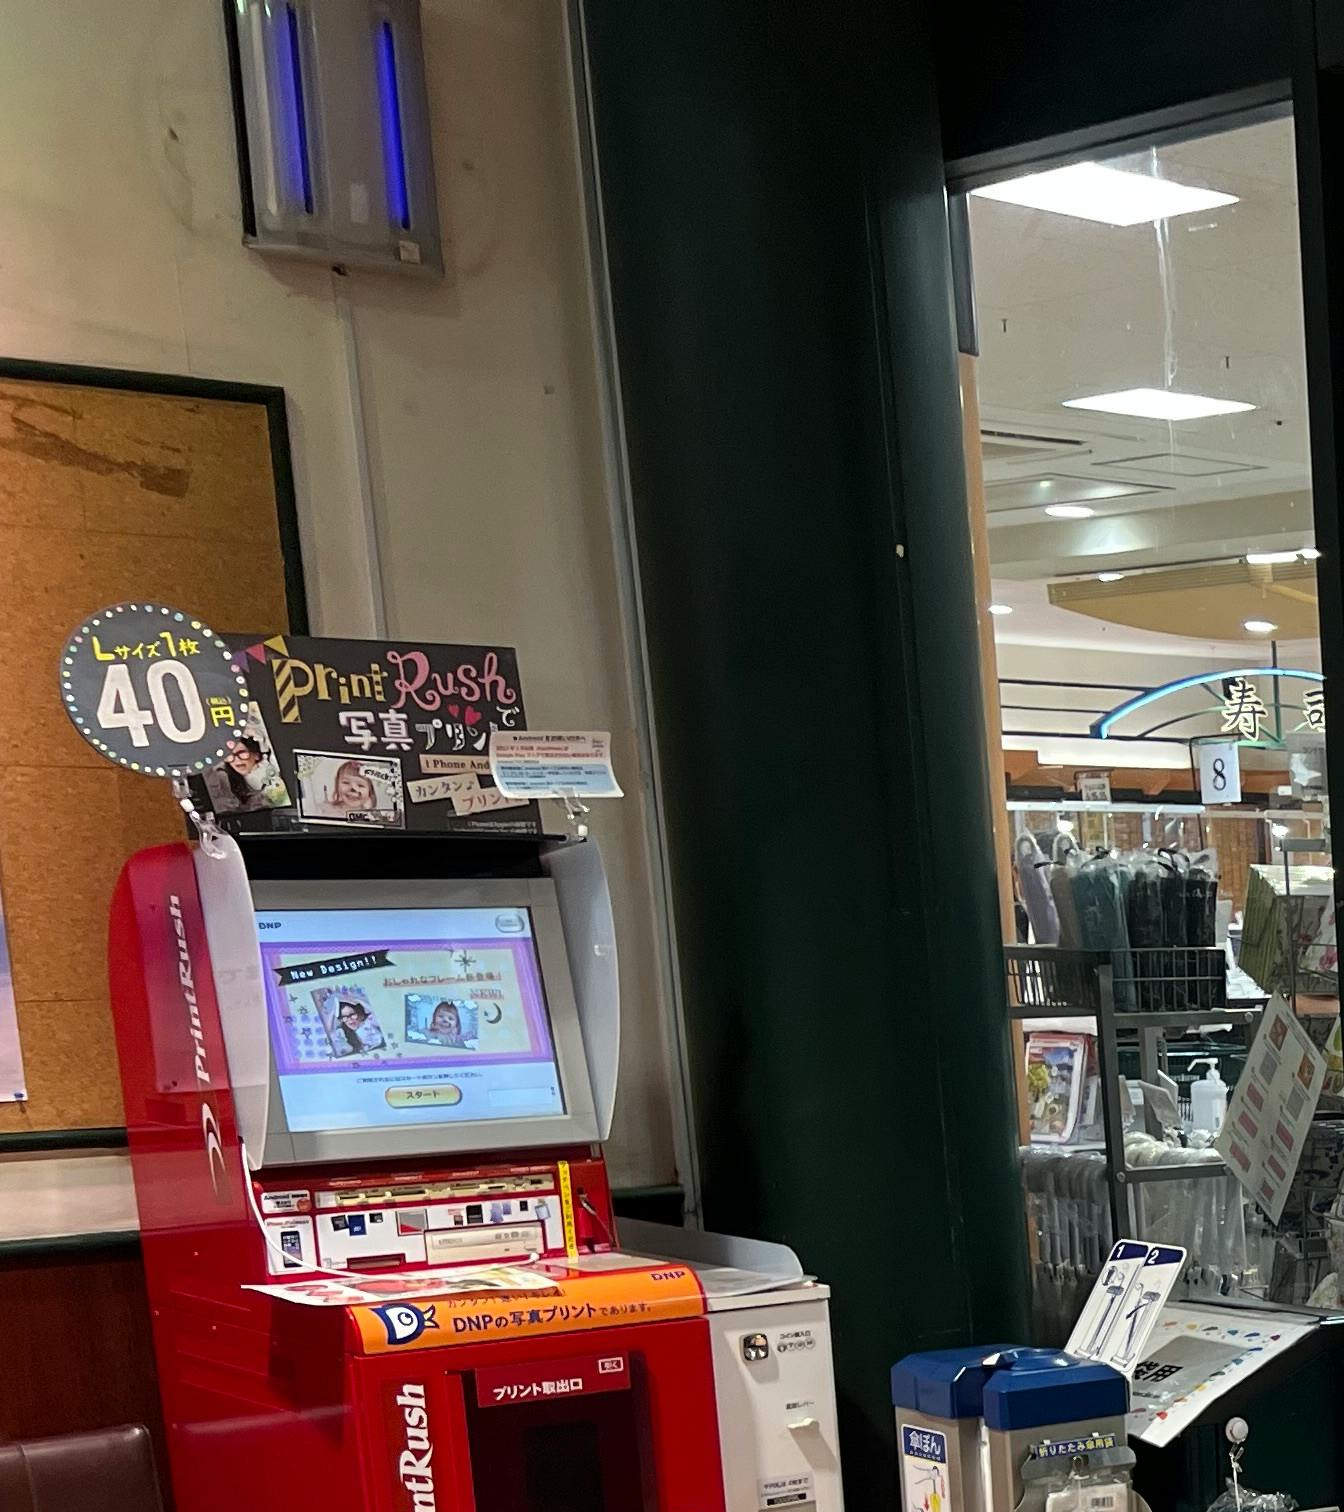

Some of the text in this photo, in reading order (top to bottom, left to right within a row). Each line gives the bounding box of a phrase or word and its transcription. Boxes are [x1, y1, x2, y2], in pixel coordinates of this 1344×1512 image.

[271, 650, 517, 723] Print Rush
[97, 659, 235, 748] 40 円
[433, 760, 466, 770] Phone
[1212, 757, 1227, 791] 8
[258, 921, 282, 930] DNP
[289, 955, 378, 981] New Design!!
[168, 894, 212, 1084] PrintRush
[405, 1090, 440, 1101] スタート
[1116, 1244, 1125, 1259] 1
[1147, 1249, 1159, 1265] 2
[651, 1270, 687, 1282] DNP
[452, 1302, 597, 1334] DNPの写真プリント
[492, 1377, 584, 1401] プリント取出口
